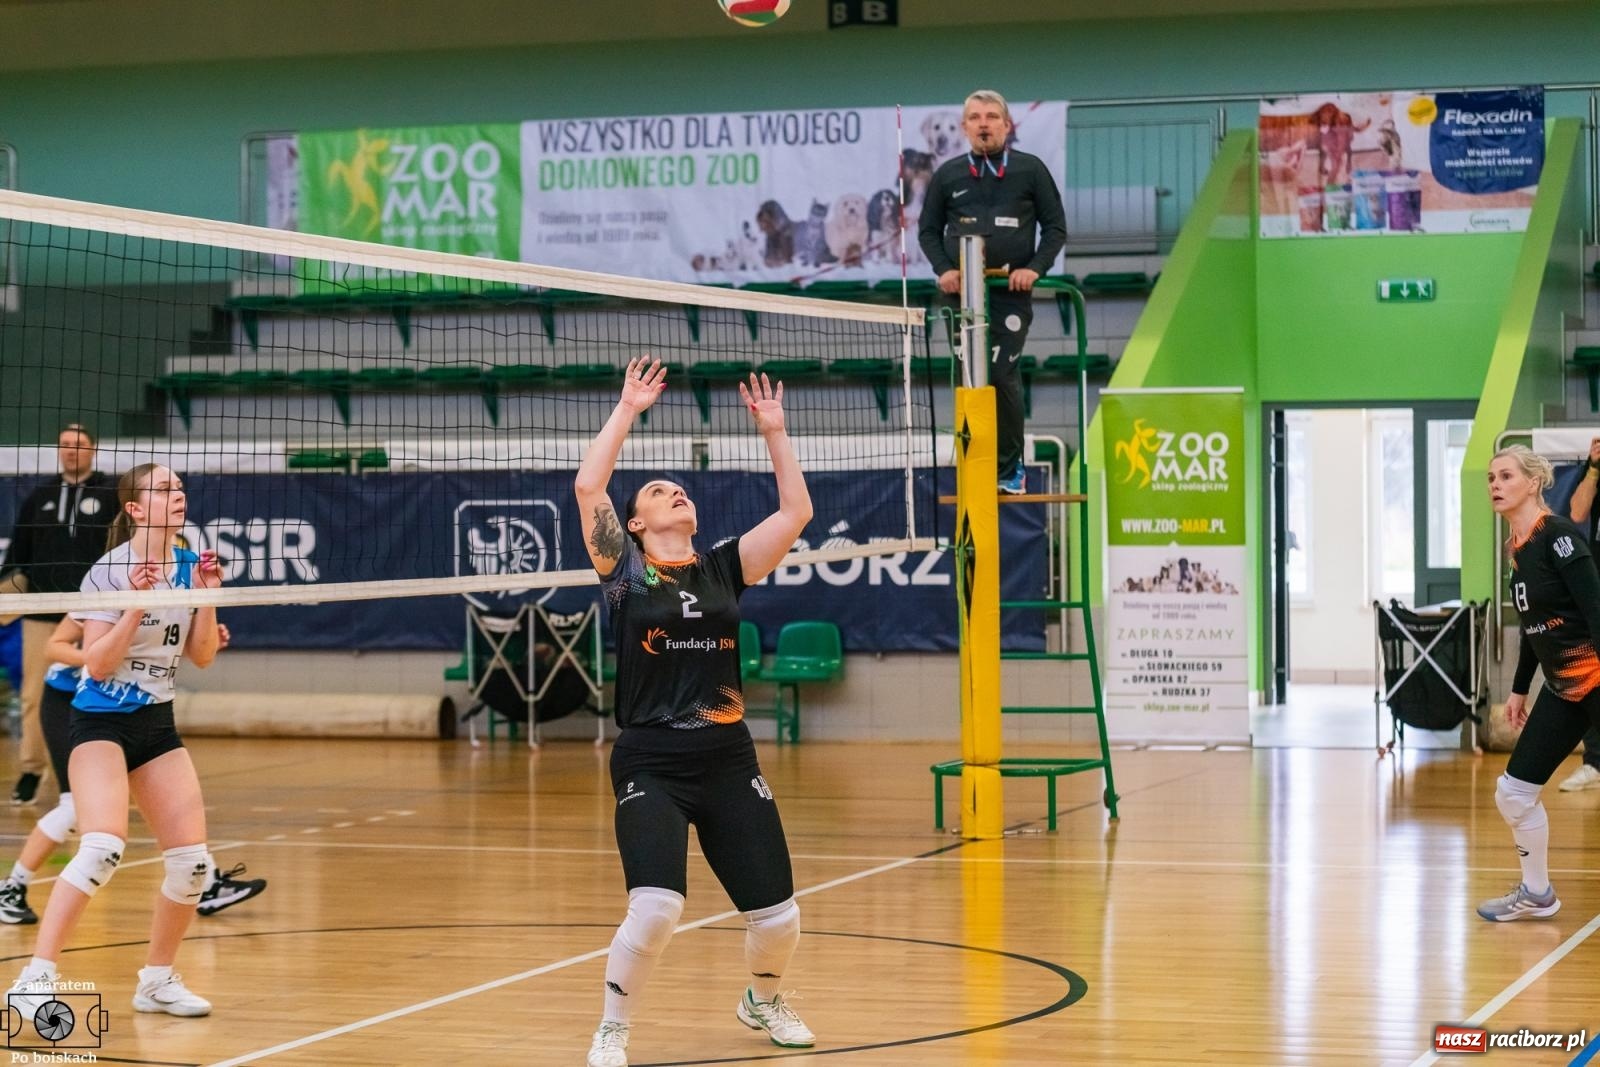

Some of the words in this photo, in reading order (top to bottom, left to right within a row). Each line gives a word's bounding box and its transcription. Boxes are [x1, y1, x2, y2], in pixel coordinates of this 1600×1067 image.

[862, 1, 888, 21] B
[1444, 108, 1533, 126] Flexadin
[539, 118, 674, 152] WSZYSTKO
[684, 116, 733, 149] DLA
[740, 111, 861, 146] TWOJEGO
[390, 141, 500, 181] ZOO
[538, 155, 696, 191] DOMOWEGO
[706, 153, 759, 186] ZOO
[382, 181, 497, 222] MAR
[1155, 431, 1230, 457] ZOO
[1151, 456, 1229, 481] MAR
[1121, 518, 1227, 534] WWW.ZOO-MAR.PL
[678, 590, 703, 618] 2
[1514, 581, 1529, 613] 13
[161, 623, 181, 647] 19
[666, 637, 717, 652] Fundacja
[1117, 628, 1234, 641] ZAPRASZAMY
[1146, 662, 1209, 671] SŁOWACKIEGO
[1132, 675, 1174, 684] OPAWSKA
[1161, 687, 1197, 697] RUDZKA
[627, 781, 635, 794] 2
